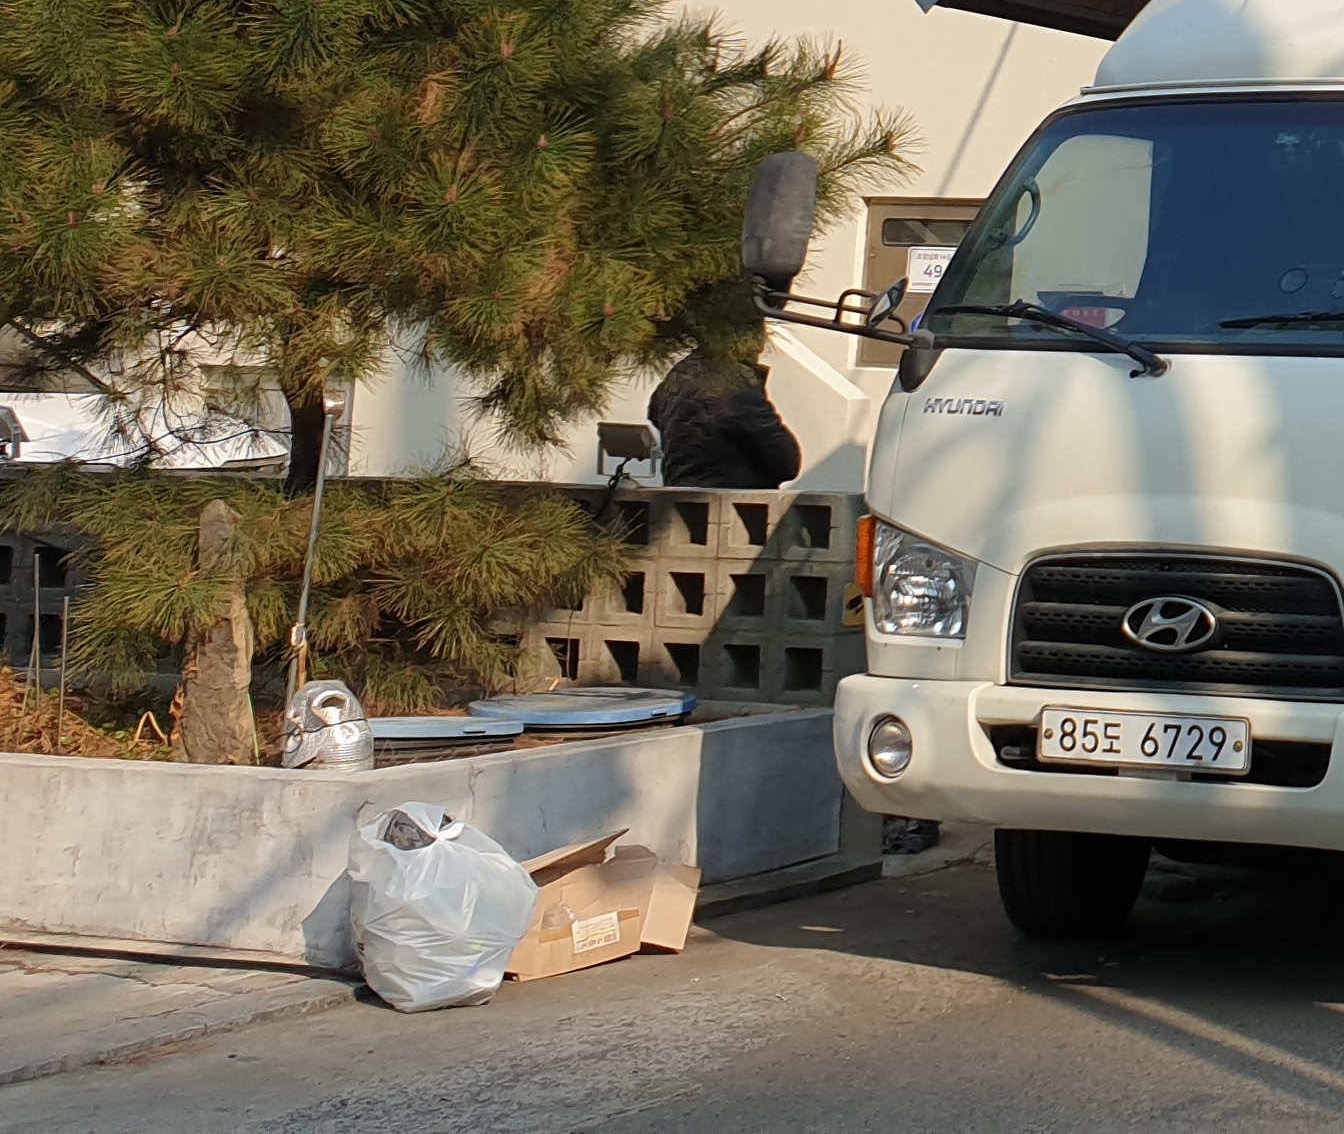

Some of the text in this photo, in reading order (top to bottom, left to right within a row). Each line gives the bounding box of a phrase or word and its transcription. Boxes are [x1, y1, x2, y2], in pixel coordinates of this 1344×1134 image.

[923, 264, 943, 278] 49
[923, 397, 1005, 418] HYUNDAI
[1059, 717, 1228, 762] 85도 6729
